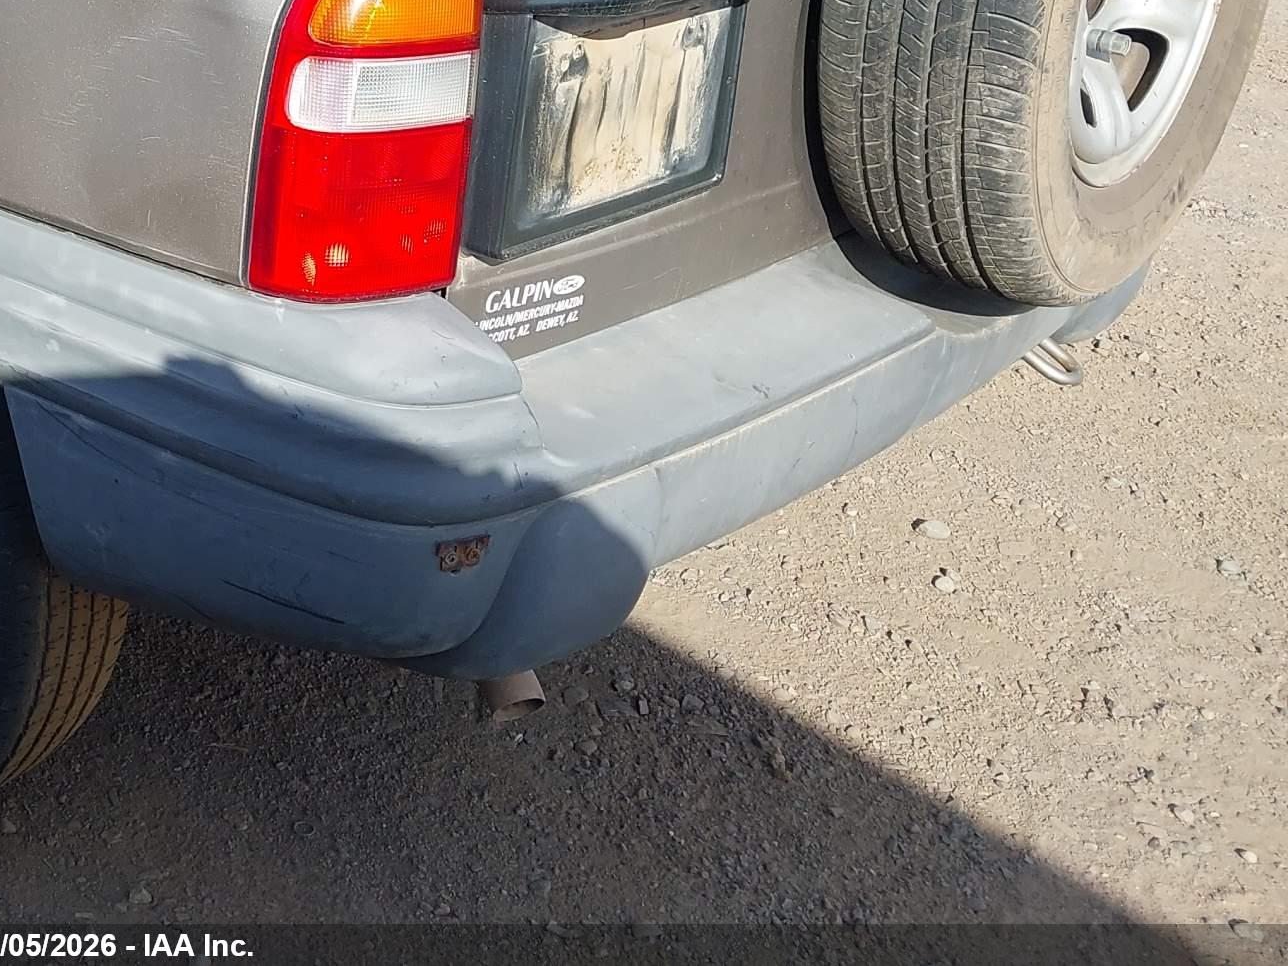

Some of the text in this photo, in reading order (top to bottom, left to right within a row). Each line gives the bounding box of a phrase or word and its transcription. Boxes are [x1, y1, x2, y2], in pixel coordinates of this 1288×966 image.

[475, 294, 584, 331] INCOLN/MERCURY-MAZDA
[485, 278, 554, 313] GALPIN
[535, 313, 566, 332] DEWEY,
